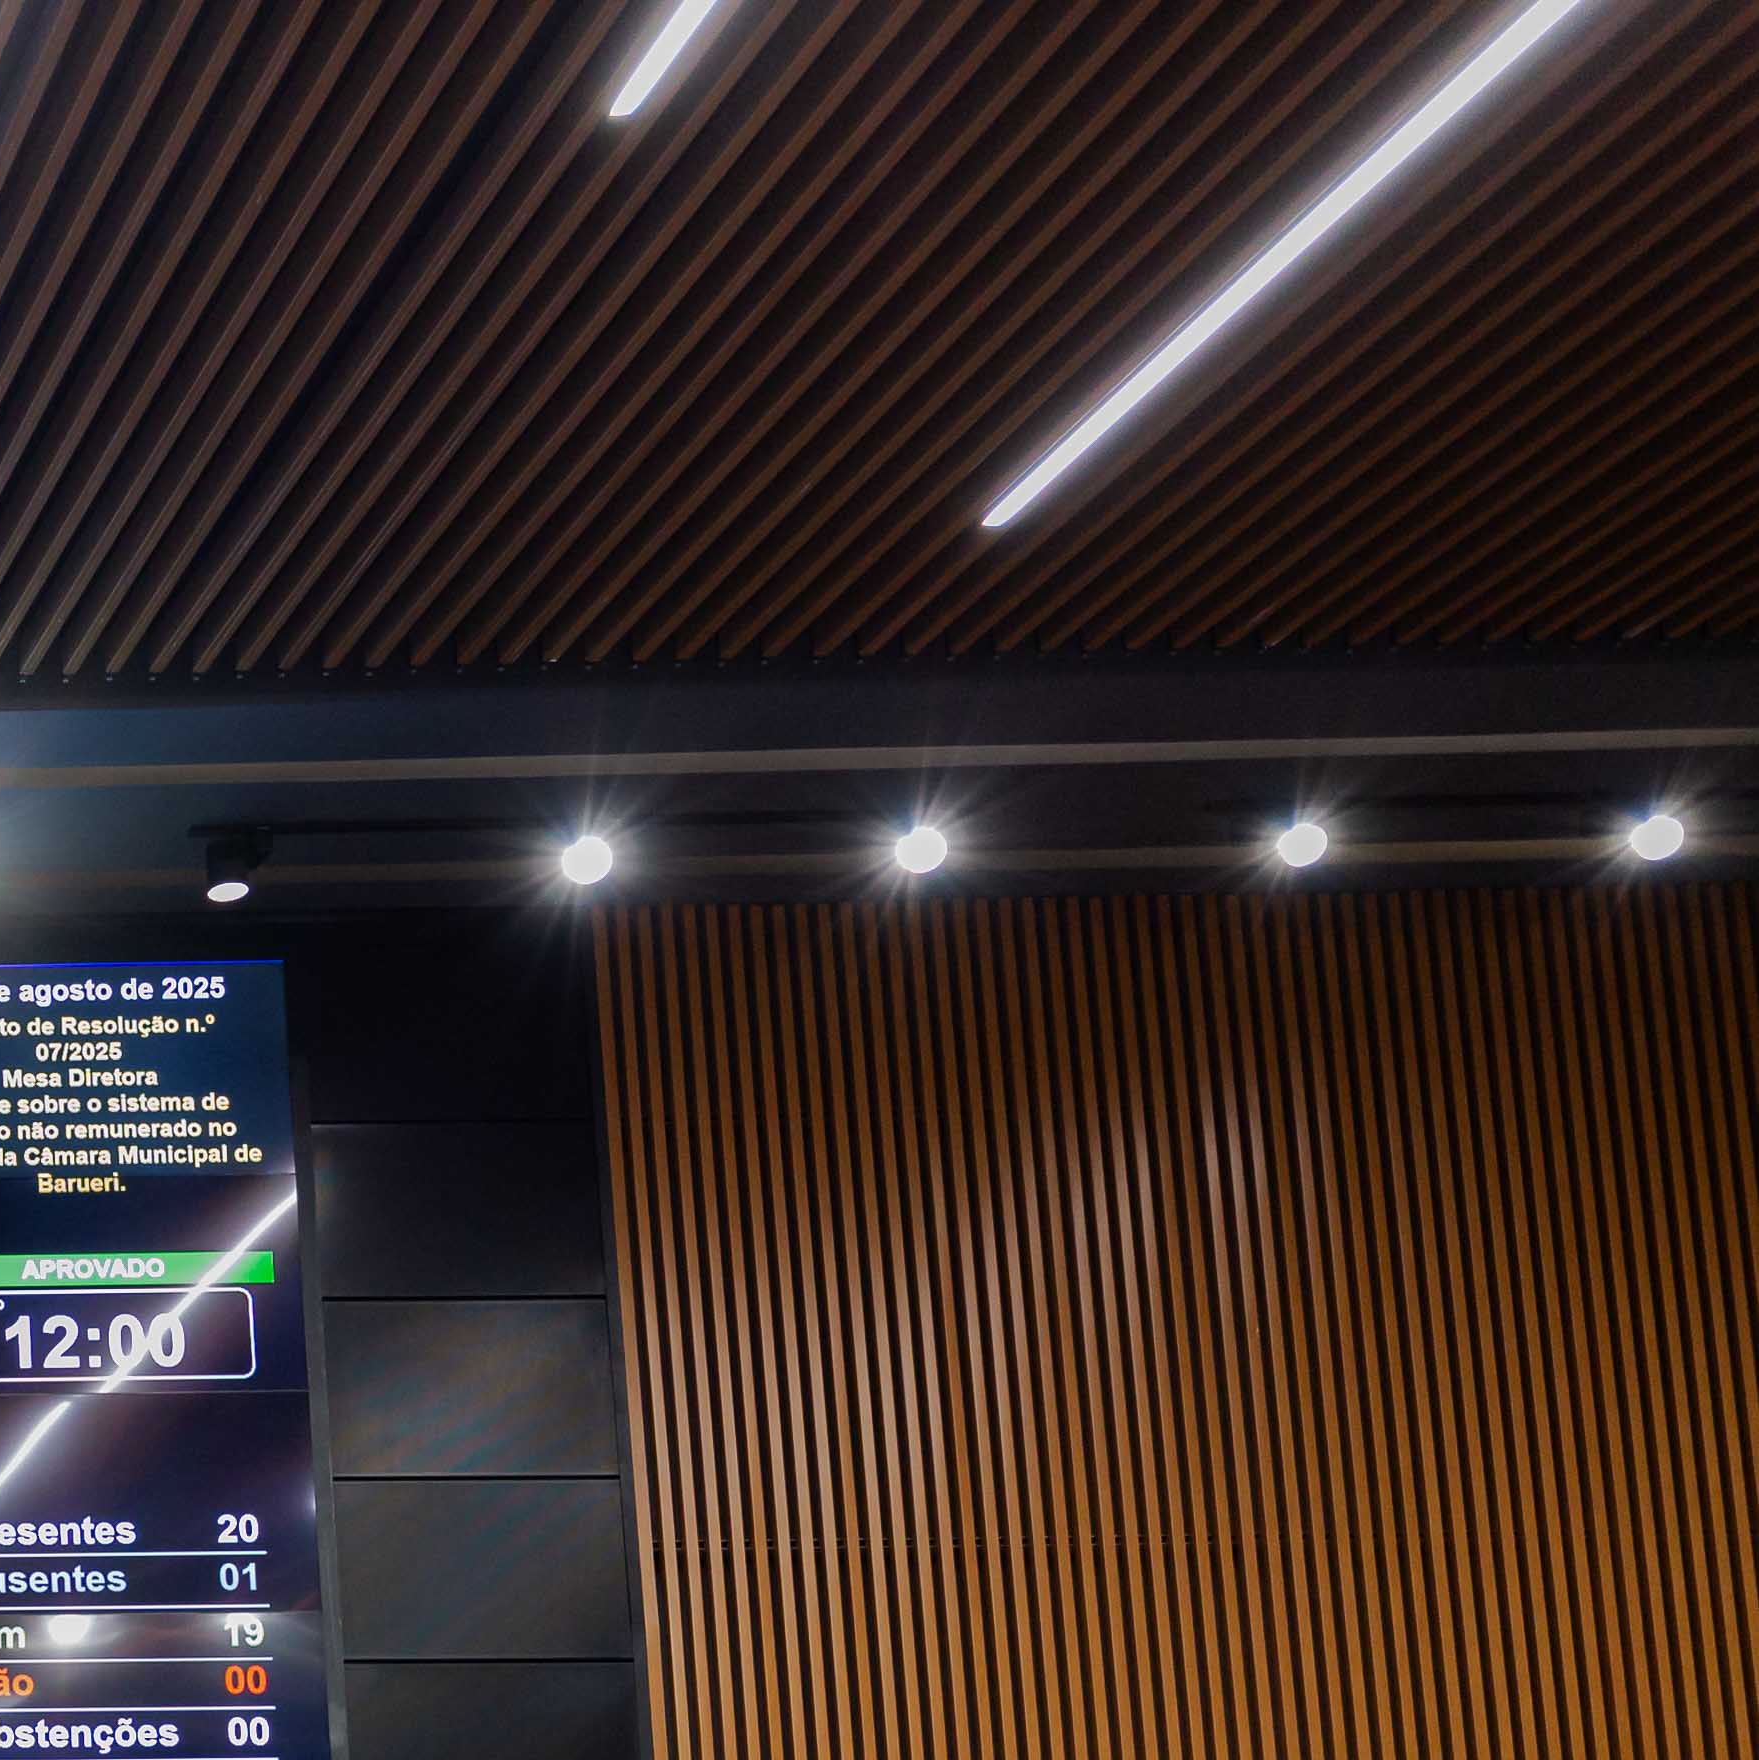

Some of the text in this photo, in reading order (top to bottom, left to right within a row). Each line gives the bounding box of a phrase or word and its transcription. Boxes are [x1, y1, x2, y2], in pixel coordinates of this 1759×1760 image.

[19, 980, 112, 1006] agosto
[121, 979, 153, 1000] de
[162, 977, 225, 999] 2025
[27, 1017, 54, 1036] de
[61, 1016, 179, 1038] Resolução
[36, 1043, 122, 1062] 07/2025
[2, 1068, 158, 1088] Mesa Diretora
[17, 1095, 80, 1114] sobre
[87, 1099, 102, 1113] o
[108, 1094, 195, 1112] sistema
[202, 1093, 229, 1111] de
[17, 1121, 59, 1139] não
[65, 1120, 202, 1139] remunerado
[208, 1120, 237, 1137] no
[23, 1146, 111, 1166] Câmara
[118, 1145, 228, 1169] Municipal
[234, 1145, 262, 1163] de
[38, 1172, 126, 1194] Barueri.
[21, 1258, 165, 1280] APROVADO
[4, 1313, 185, 1369] 12:00
[217, 1514, 259, 1544] 20
[219, 1563, 257, 1591] 01
[224, 1618, 265, 1647] 19
[225, 1665, 267, 1695] 00
[228, 1717, 270, 1747] 00
